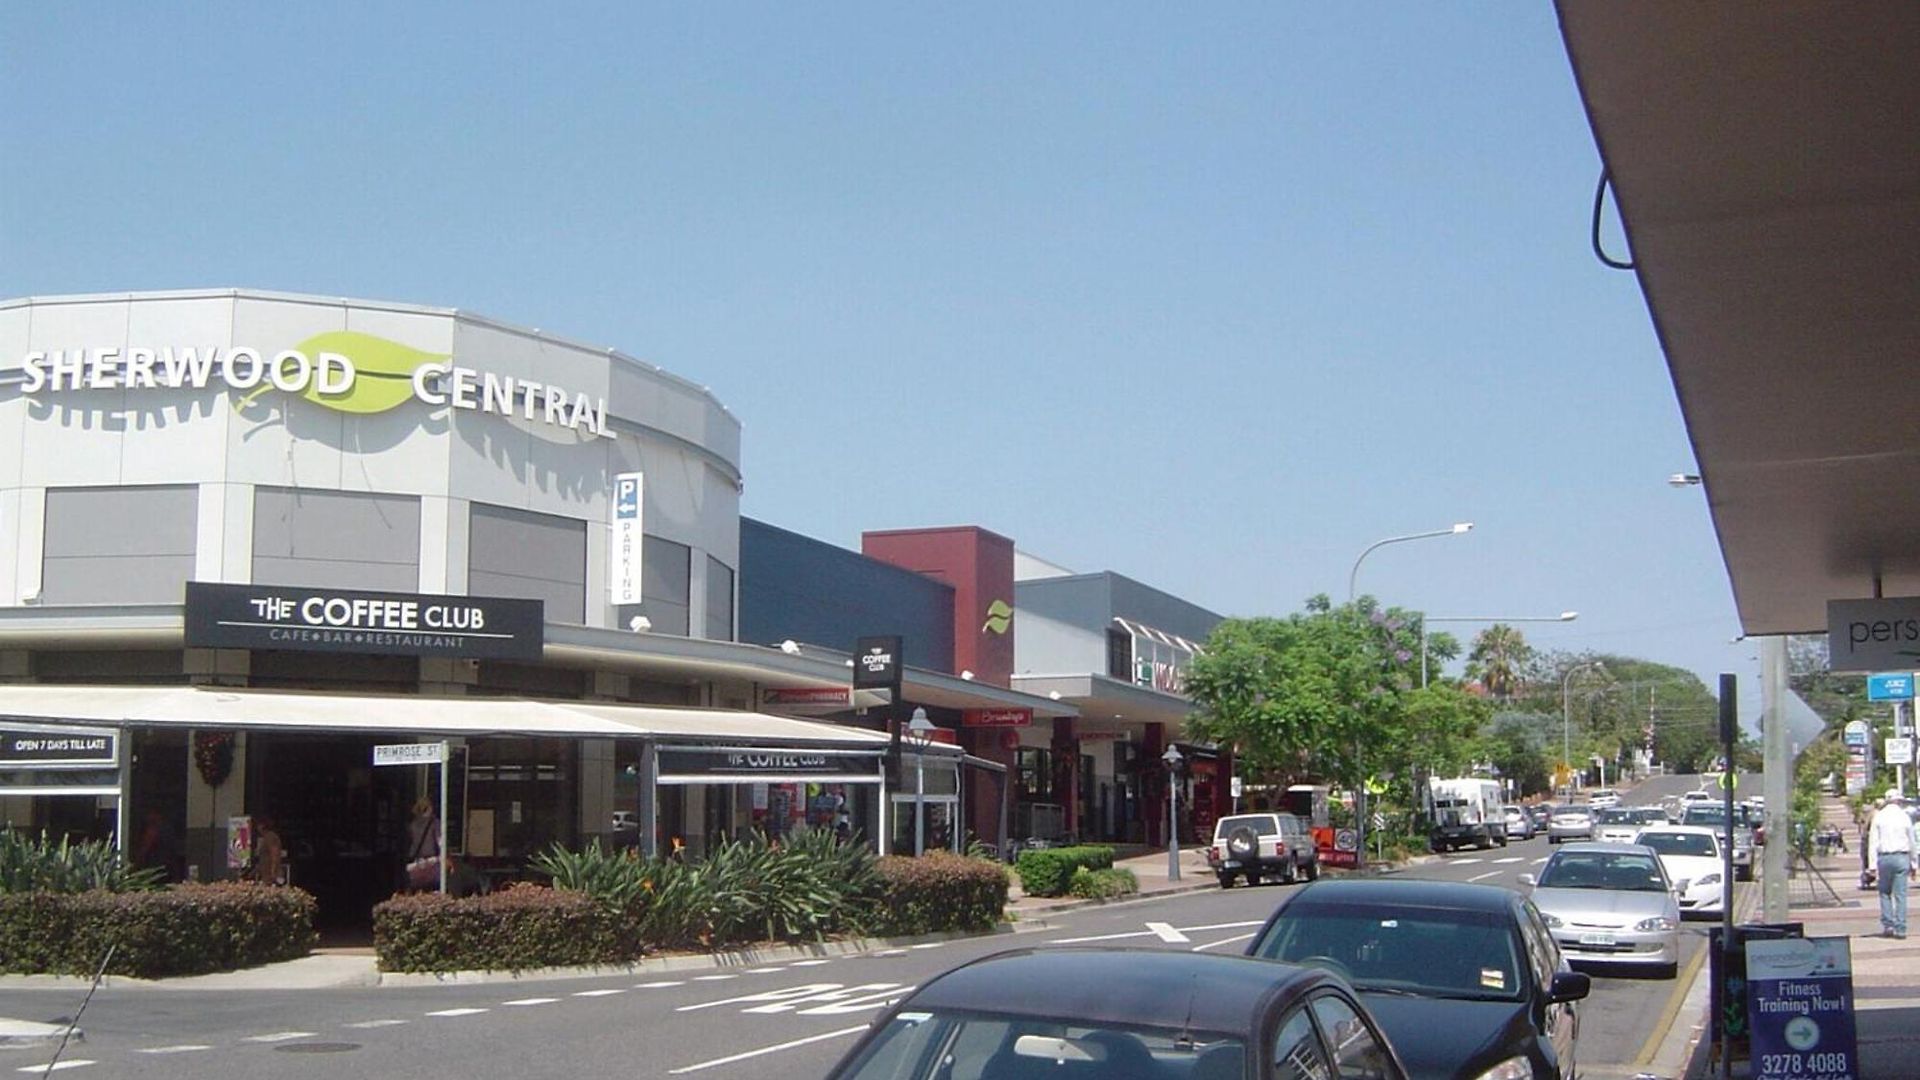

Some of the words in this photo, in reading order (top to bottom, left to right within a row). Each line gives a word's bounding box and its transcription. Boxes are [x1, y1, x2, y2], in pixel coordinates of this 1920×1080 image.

[21, 346, 356, 394] SHERWOOD
[412, 363, 617, 439] CENTRAL
[621, 481, 634, 500] P
[623, 522, 632, 600] PARKING
[251, 597, 296, 620] THE
[302, 597, 418, 629] COFFEE
[425, 606, 484, 629] CLUB
[270, 629, 309, 642] CAFE
[323, 629, 352, 643] BAR
[365, 631, 465, 648] RESTAURANT
[862, 654, 891, 664] COFFEE
[15, 740, 39, 750] OPEN
[40, 740, 46, 750] 7
[47, 740, 68, 750] DAYS
[69, 740, 85, 750] TILL
[87, 739, 106, 750] LATE
[377, 746, 421, 757] PRIMROSE
[427, 745, 439, 756] ST
[1779, 981, 1821, 996] Fitness
[1758, 997, 1809, 1015] Training
[1813, 995, 1845, 1011] Now!
[1762, 1054, 1801, 1074] 3278
[1807, 1053, 1847, 1073] 4088
